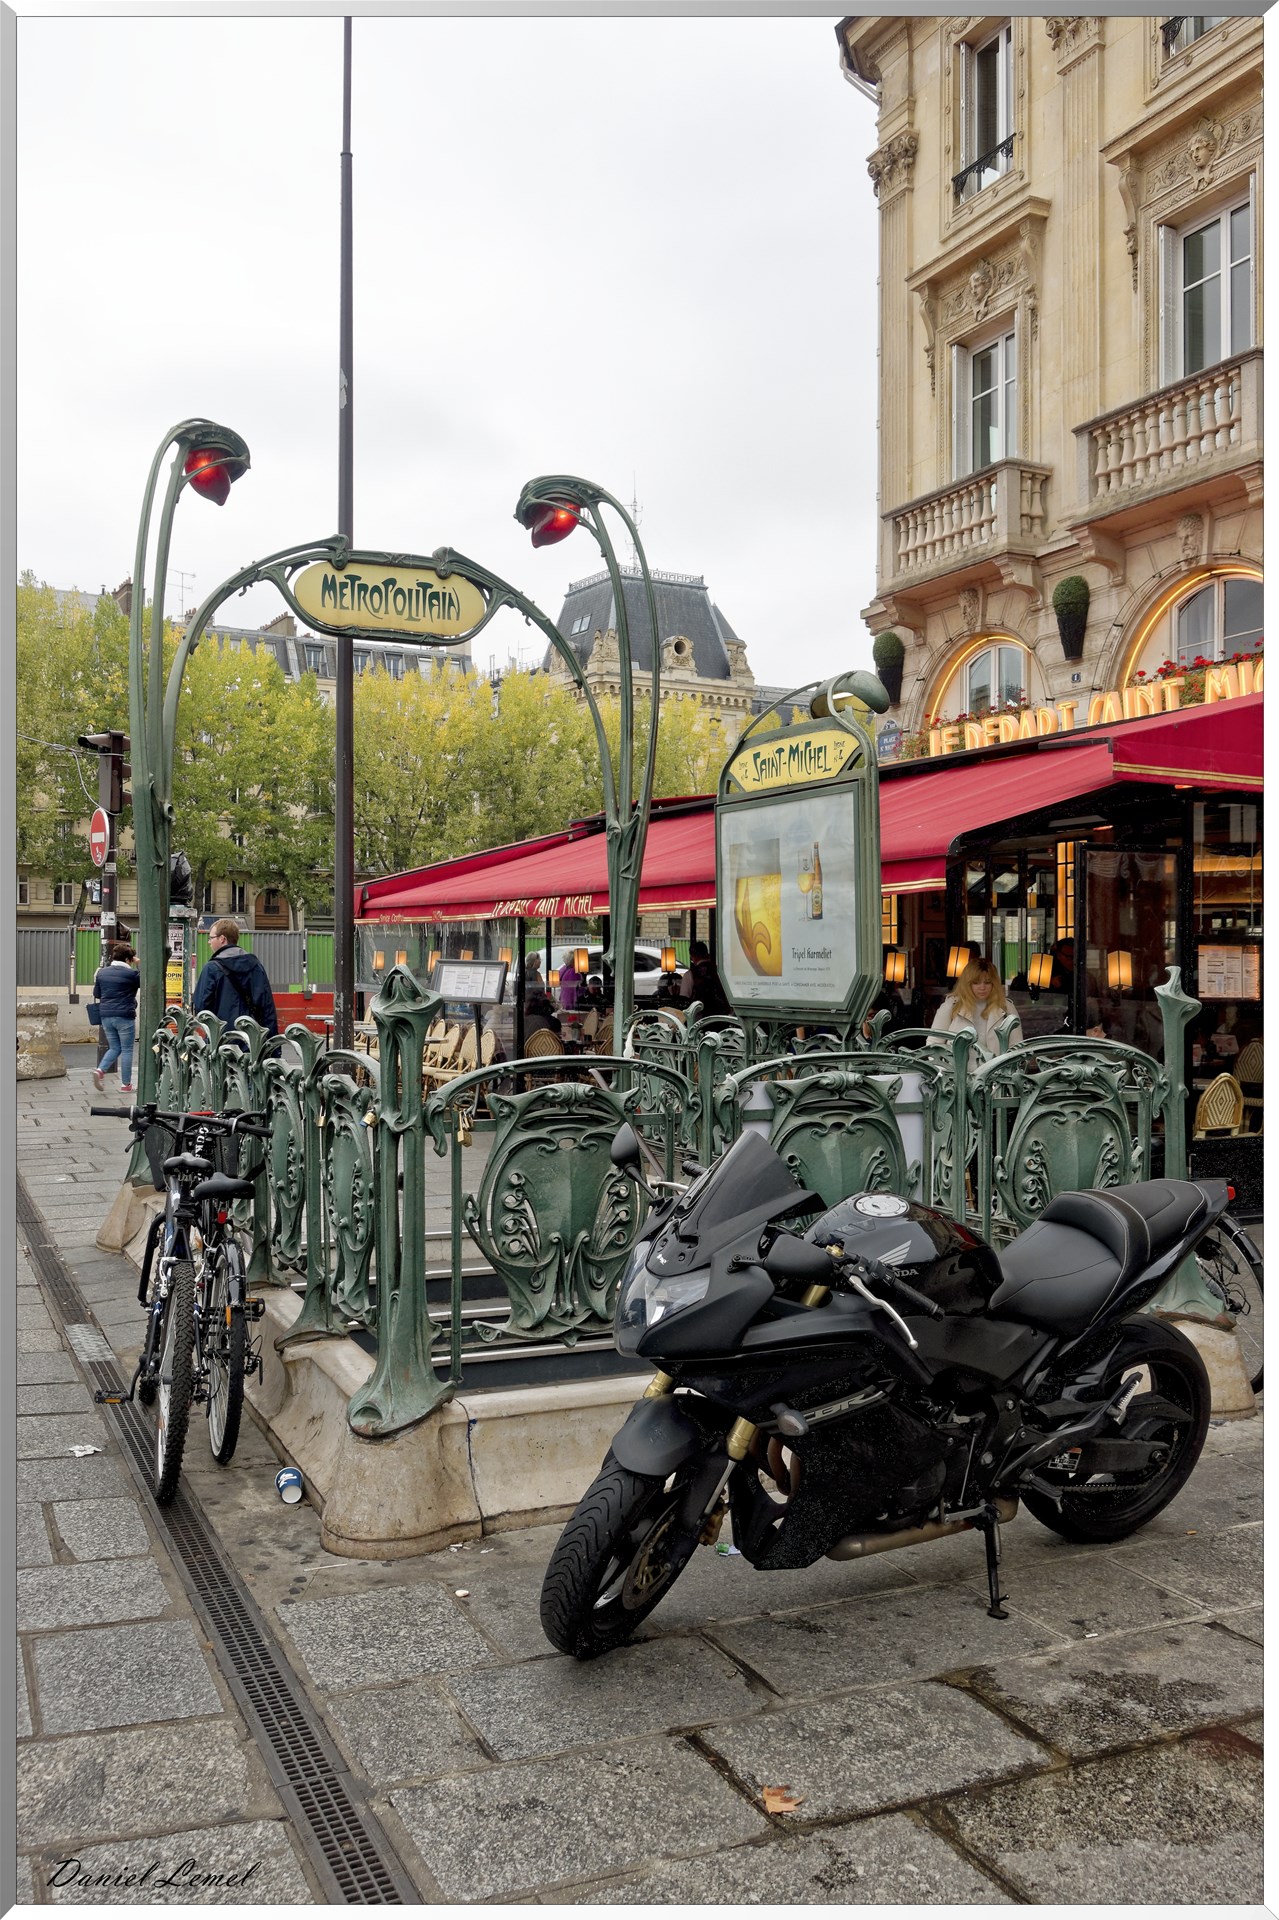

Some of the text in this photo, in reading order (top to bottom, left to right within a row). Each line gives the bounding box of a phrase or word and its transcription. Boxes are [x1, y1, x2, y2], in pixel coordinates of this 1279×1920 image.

[321, 573, 461, 623] METROPOLITAIN
[752, 740, 832, 785] SAINT-MICHEL
[562, 894, 593, 915] MICHEL
